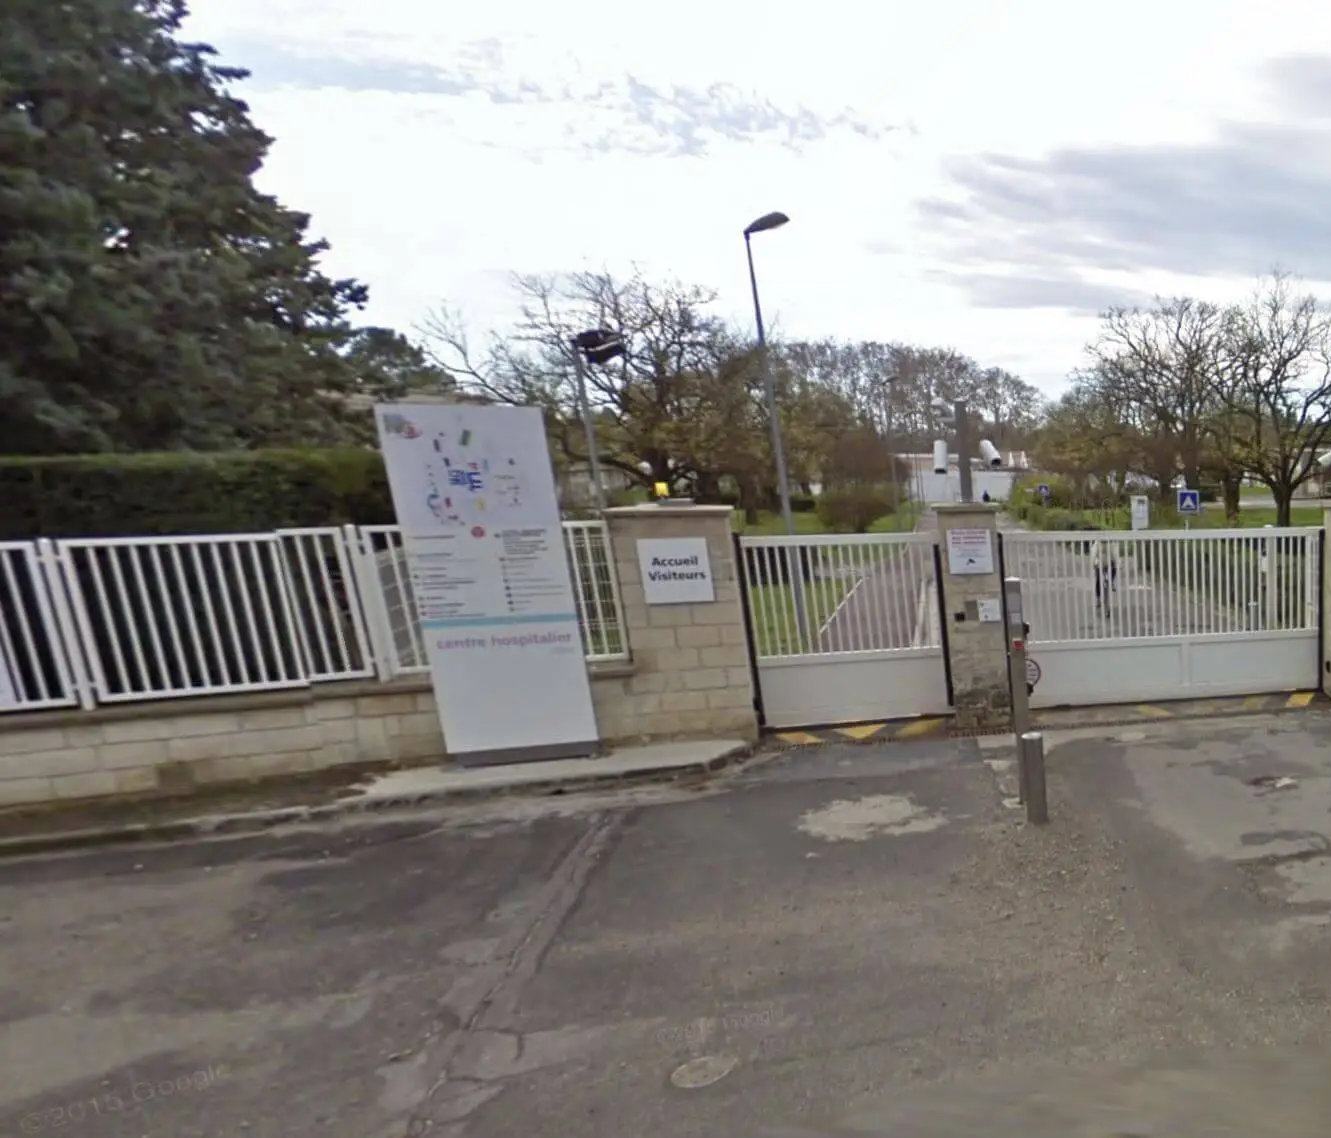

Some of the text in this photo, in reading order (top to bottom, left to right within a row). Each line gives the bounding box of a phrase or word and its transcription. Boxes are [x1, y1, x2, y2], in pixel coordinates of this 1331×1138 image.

[651, 555, 699, 567] Accueil
[648, 571, 707, 582] Visiteurs
[436, 630, 572, 650] centre hospitalier
